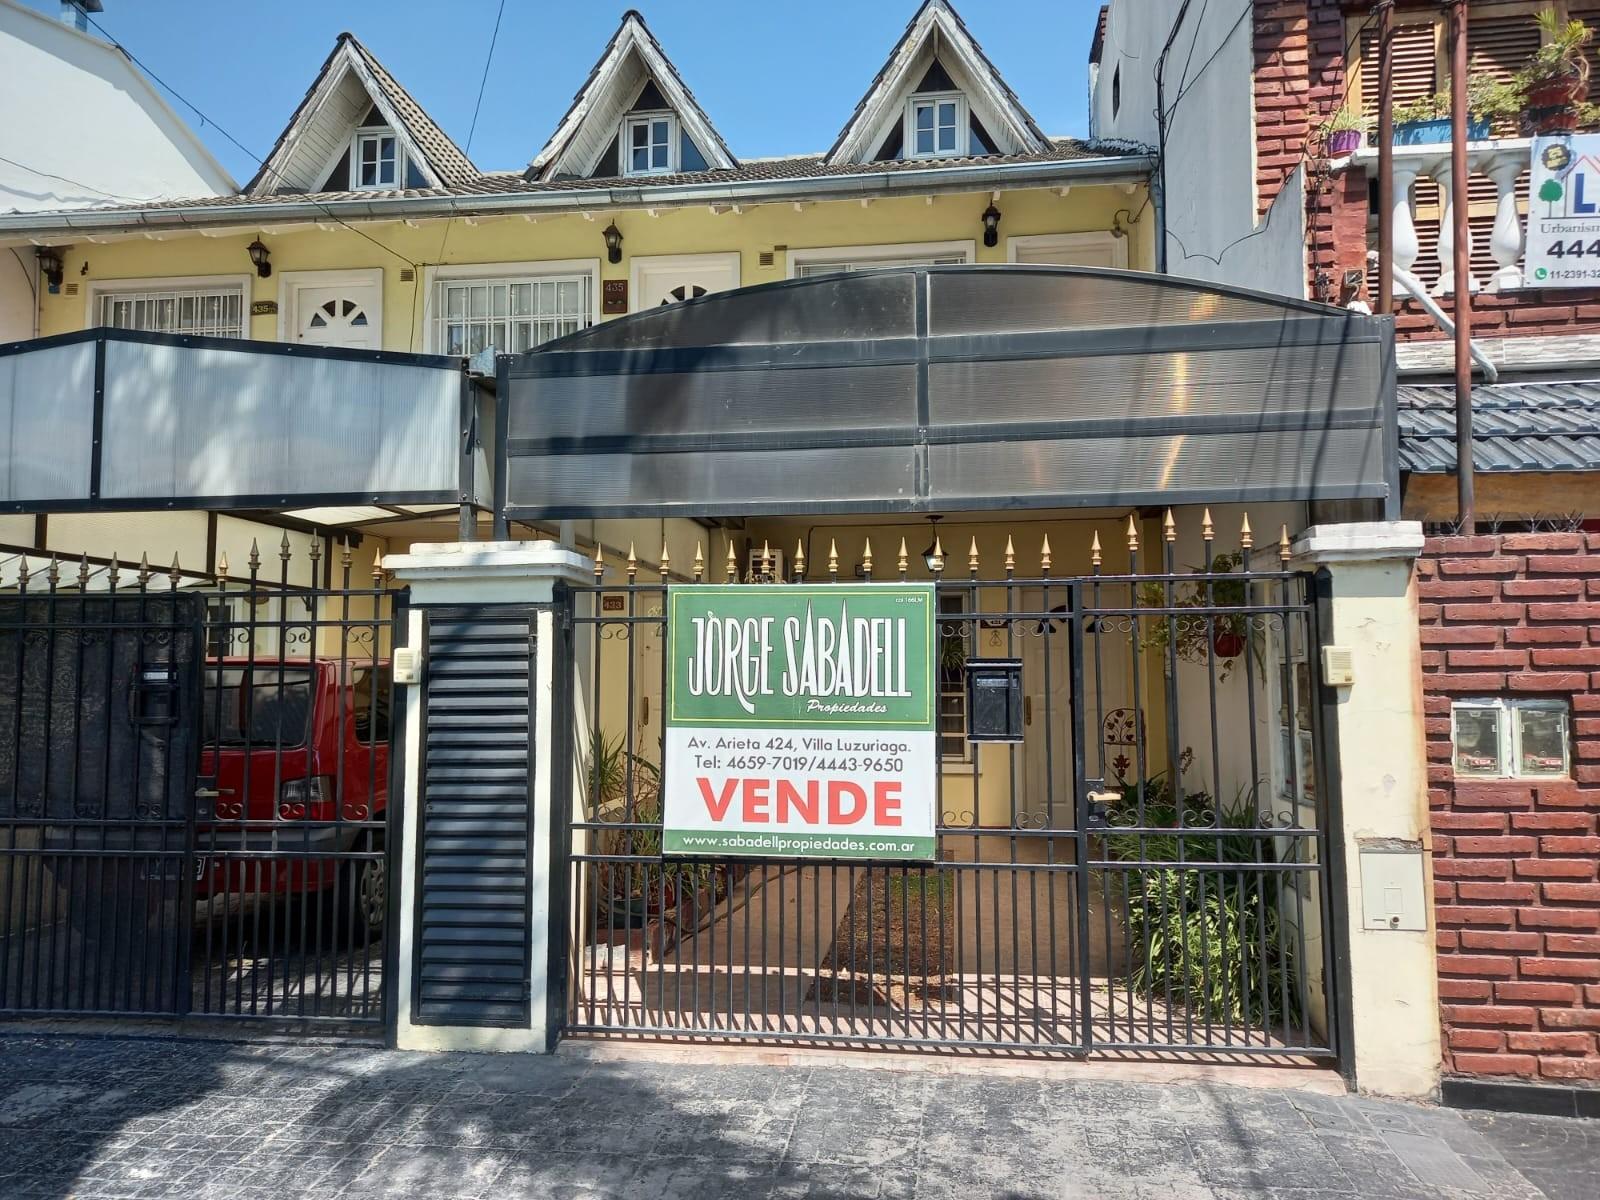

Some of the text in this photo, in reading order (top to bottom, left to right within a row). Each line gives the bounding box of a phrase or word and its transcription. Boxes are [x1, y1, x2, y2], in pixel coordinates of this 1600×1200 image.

[782, 599, 912, 698] SABADELL
[806, 699, 888, 714] Propiedades
[687, 736, 912, 756] Av. Arieta 424, Villa Luzuriaga.
[694, 754, 904, 773] Tel: 4659-7019/4443-9650
[696, 777, 902, 827] VENDE
[682, 835, 915, 853] www.sabadellpropiedades.com.ar
